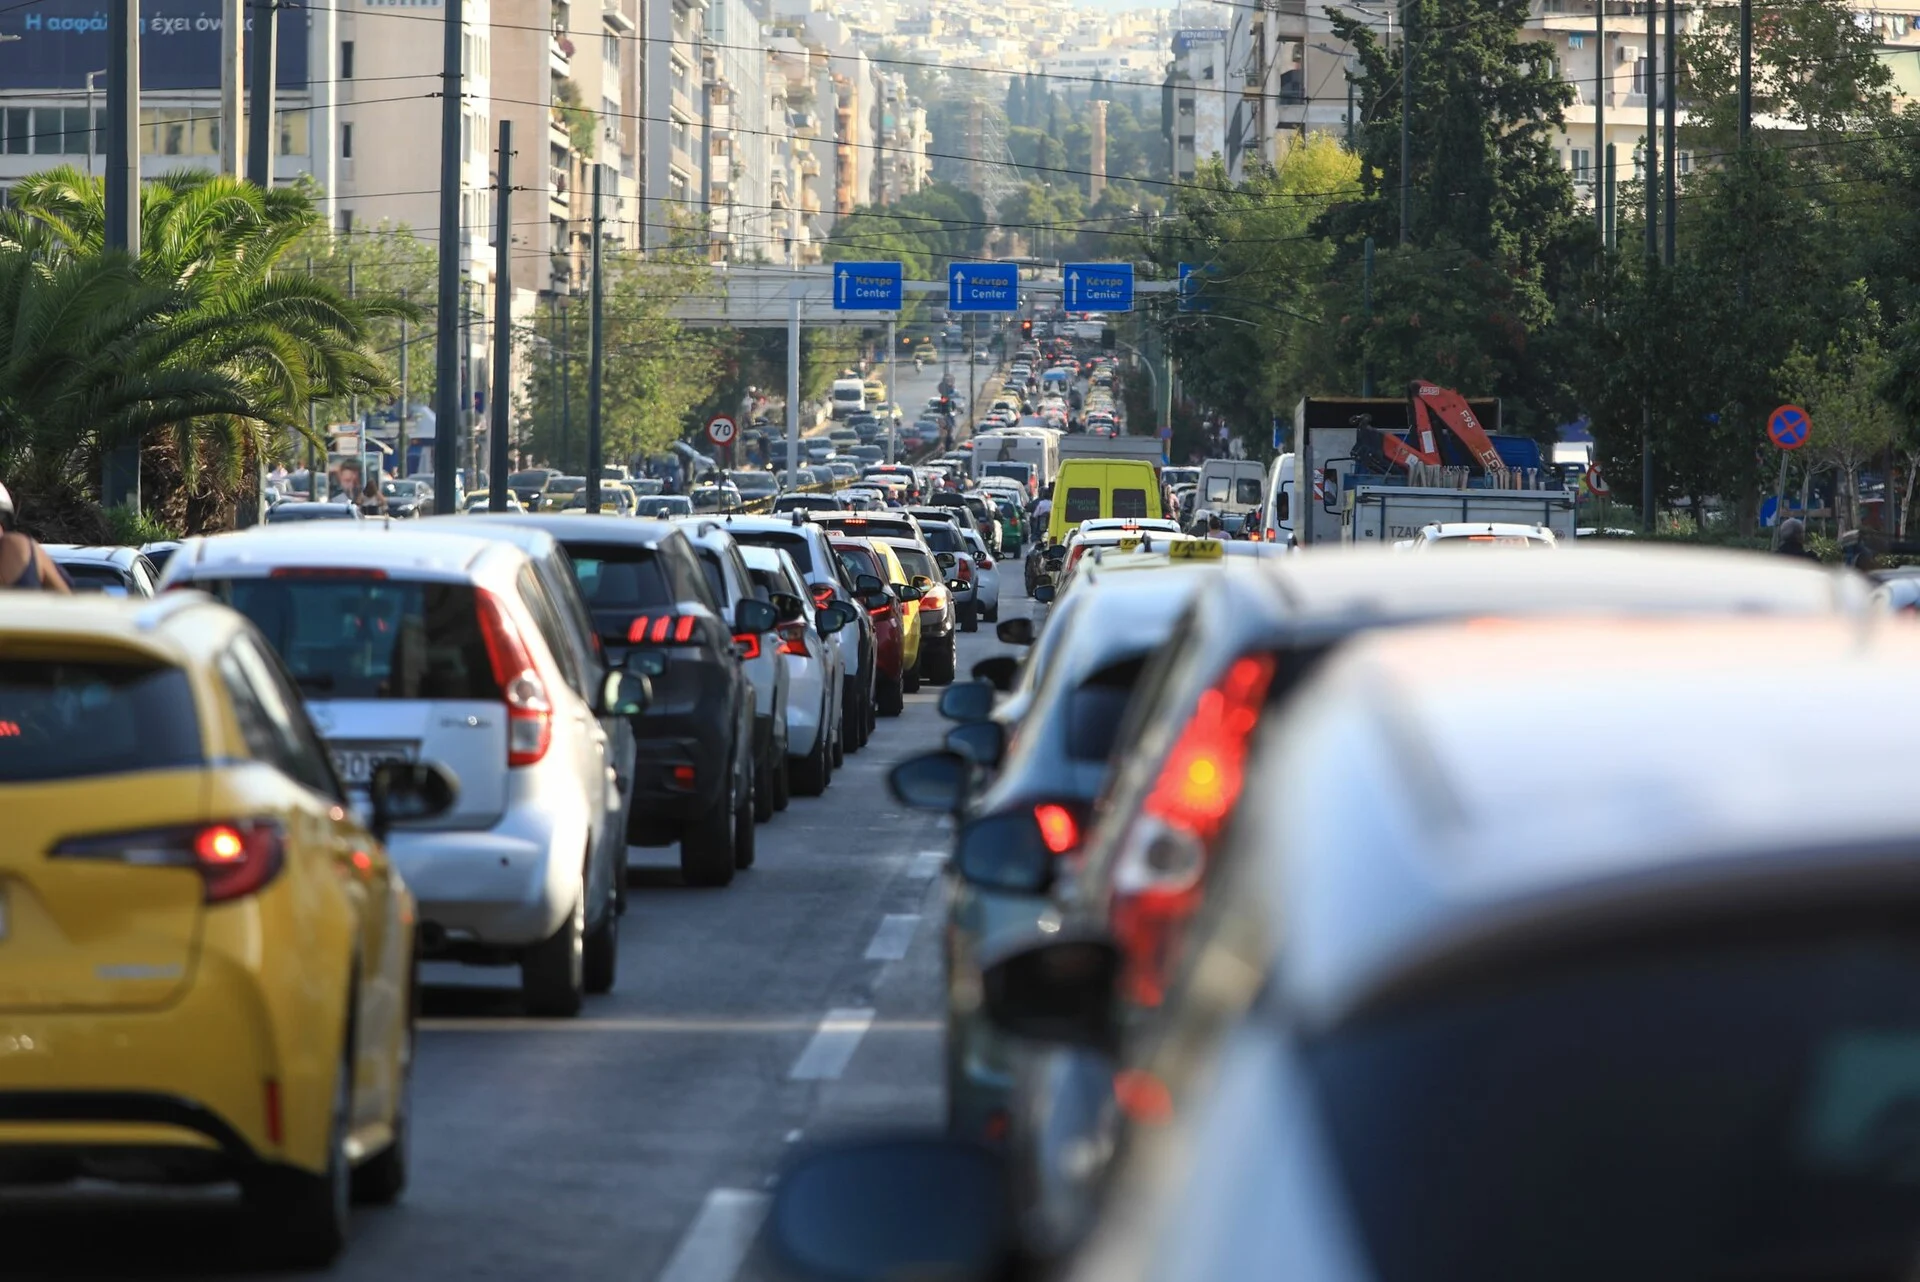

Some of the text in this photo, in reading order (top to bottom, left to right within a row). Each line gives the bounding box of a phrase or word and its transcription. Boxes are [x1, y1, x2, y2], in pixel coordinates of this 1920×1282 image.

[25, 14, 42, 30] Η
[151, 11, 190, 34] έχει
[856, 288, 890, 298] Center
[972, 289, 1006, 299] Center
[1087, 289, 1121, 299] Center
[1460, 409, 1475, 428] F95
[713, 424, 731, 436] 70
[1173, 541, 1216, 552] TAXI
